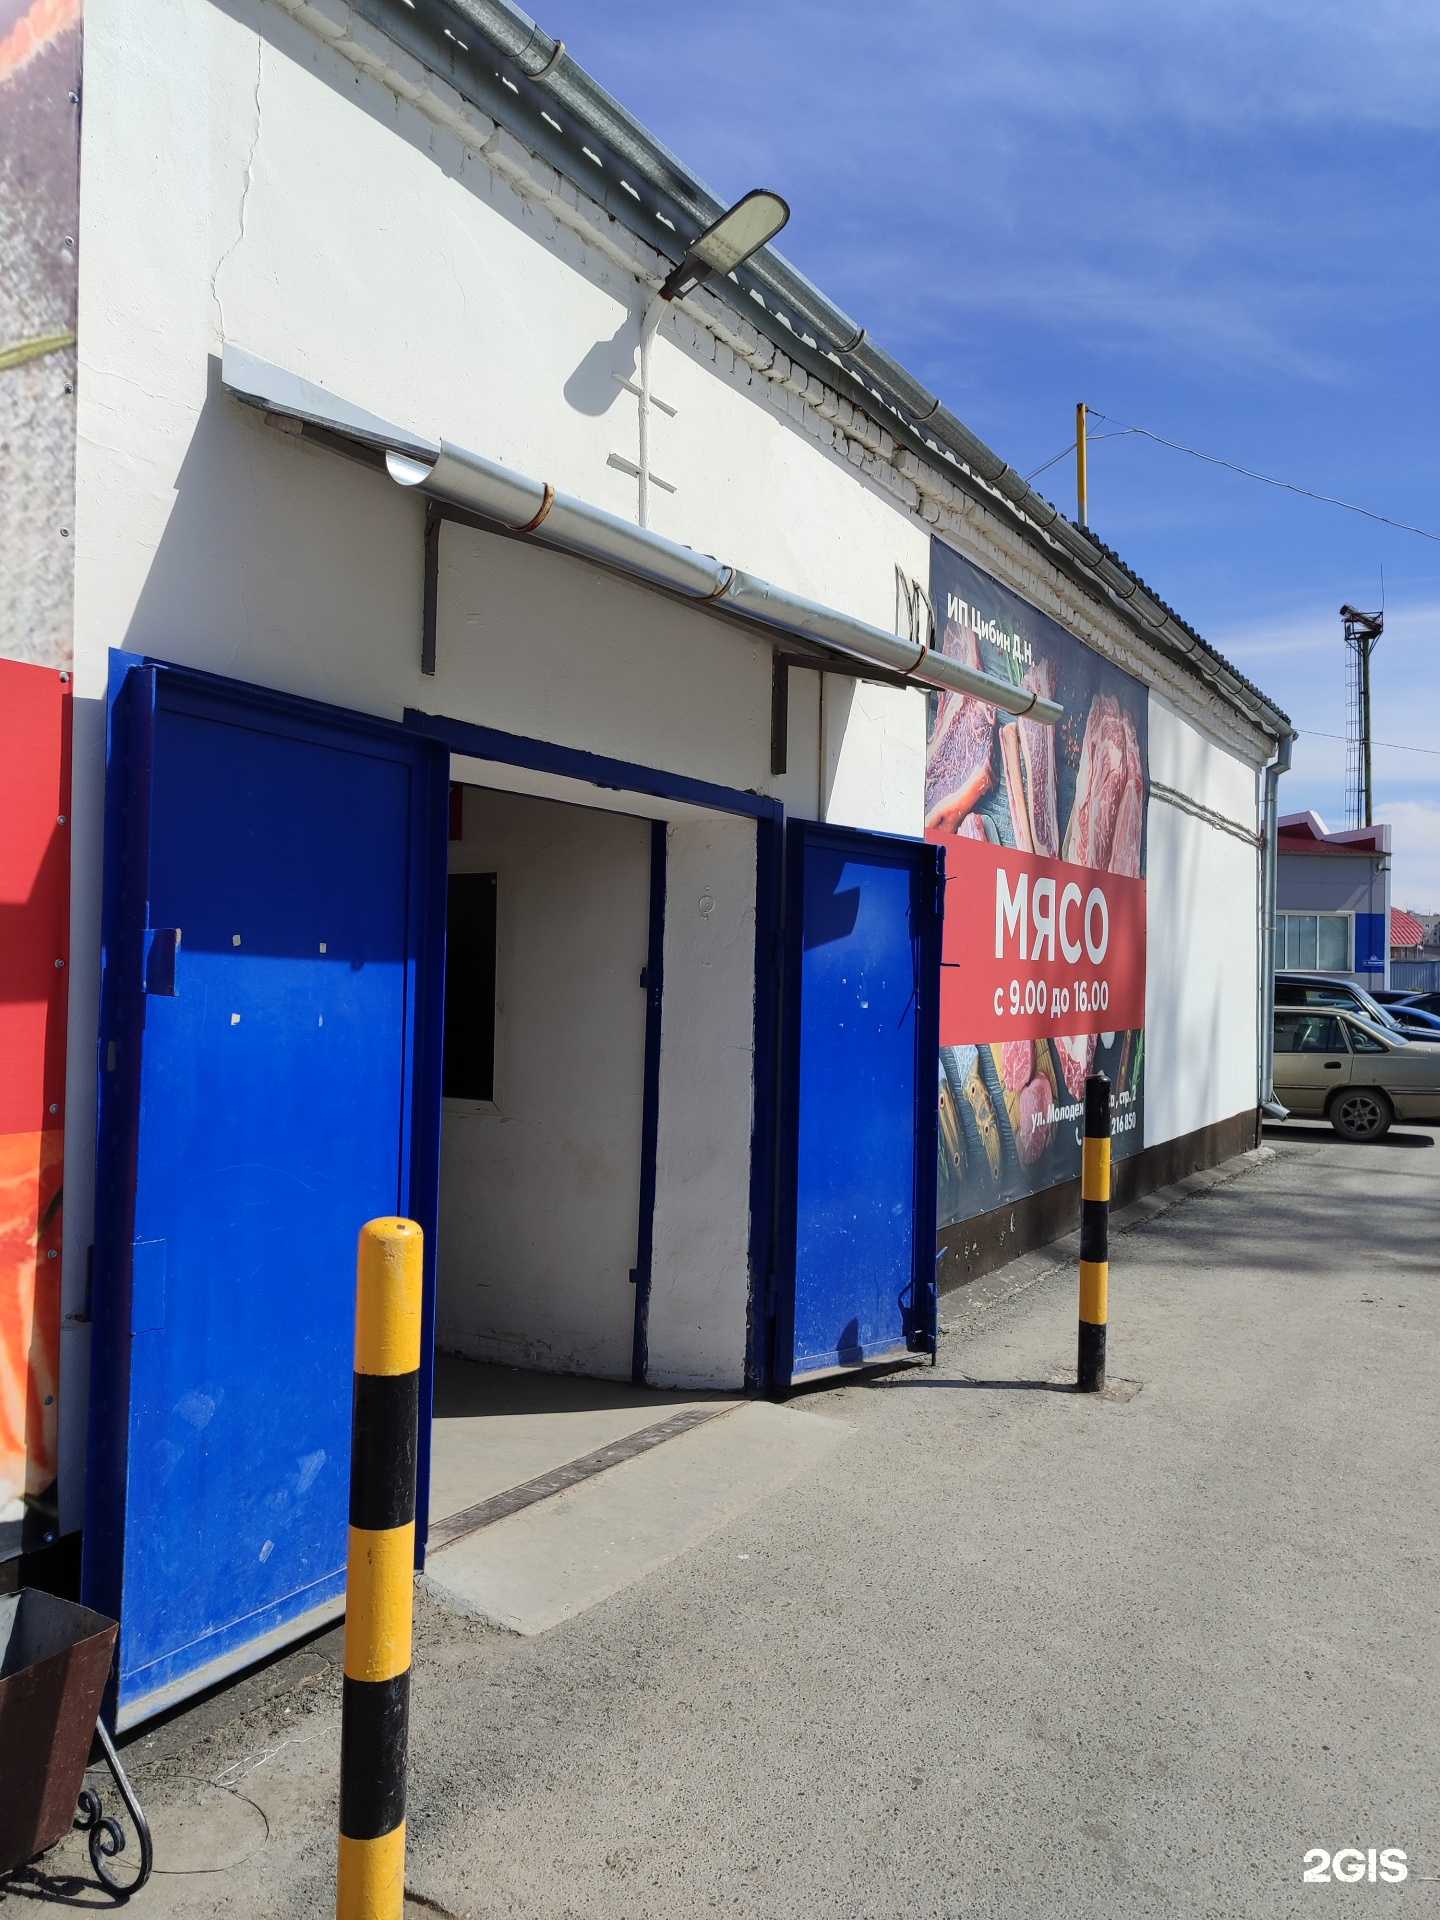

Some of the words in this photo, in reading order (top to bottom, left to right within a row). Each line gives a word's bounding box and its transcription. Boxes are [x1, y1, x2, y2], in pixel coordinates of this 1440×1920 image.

[947, 591, 968, 628] ИП
[971, 606, 1010, 653] Цибин
[995, 868, 1109, 965] МЯСО
[994, 987, 1004, 1016] с
[1009, 979, 1047, 1015] 9.00
[1050, 987, 1070, 1018] до
[1073, 980, 1109, 1013] 16.00
[1031, 1111, 1045, 1134] ул.
